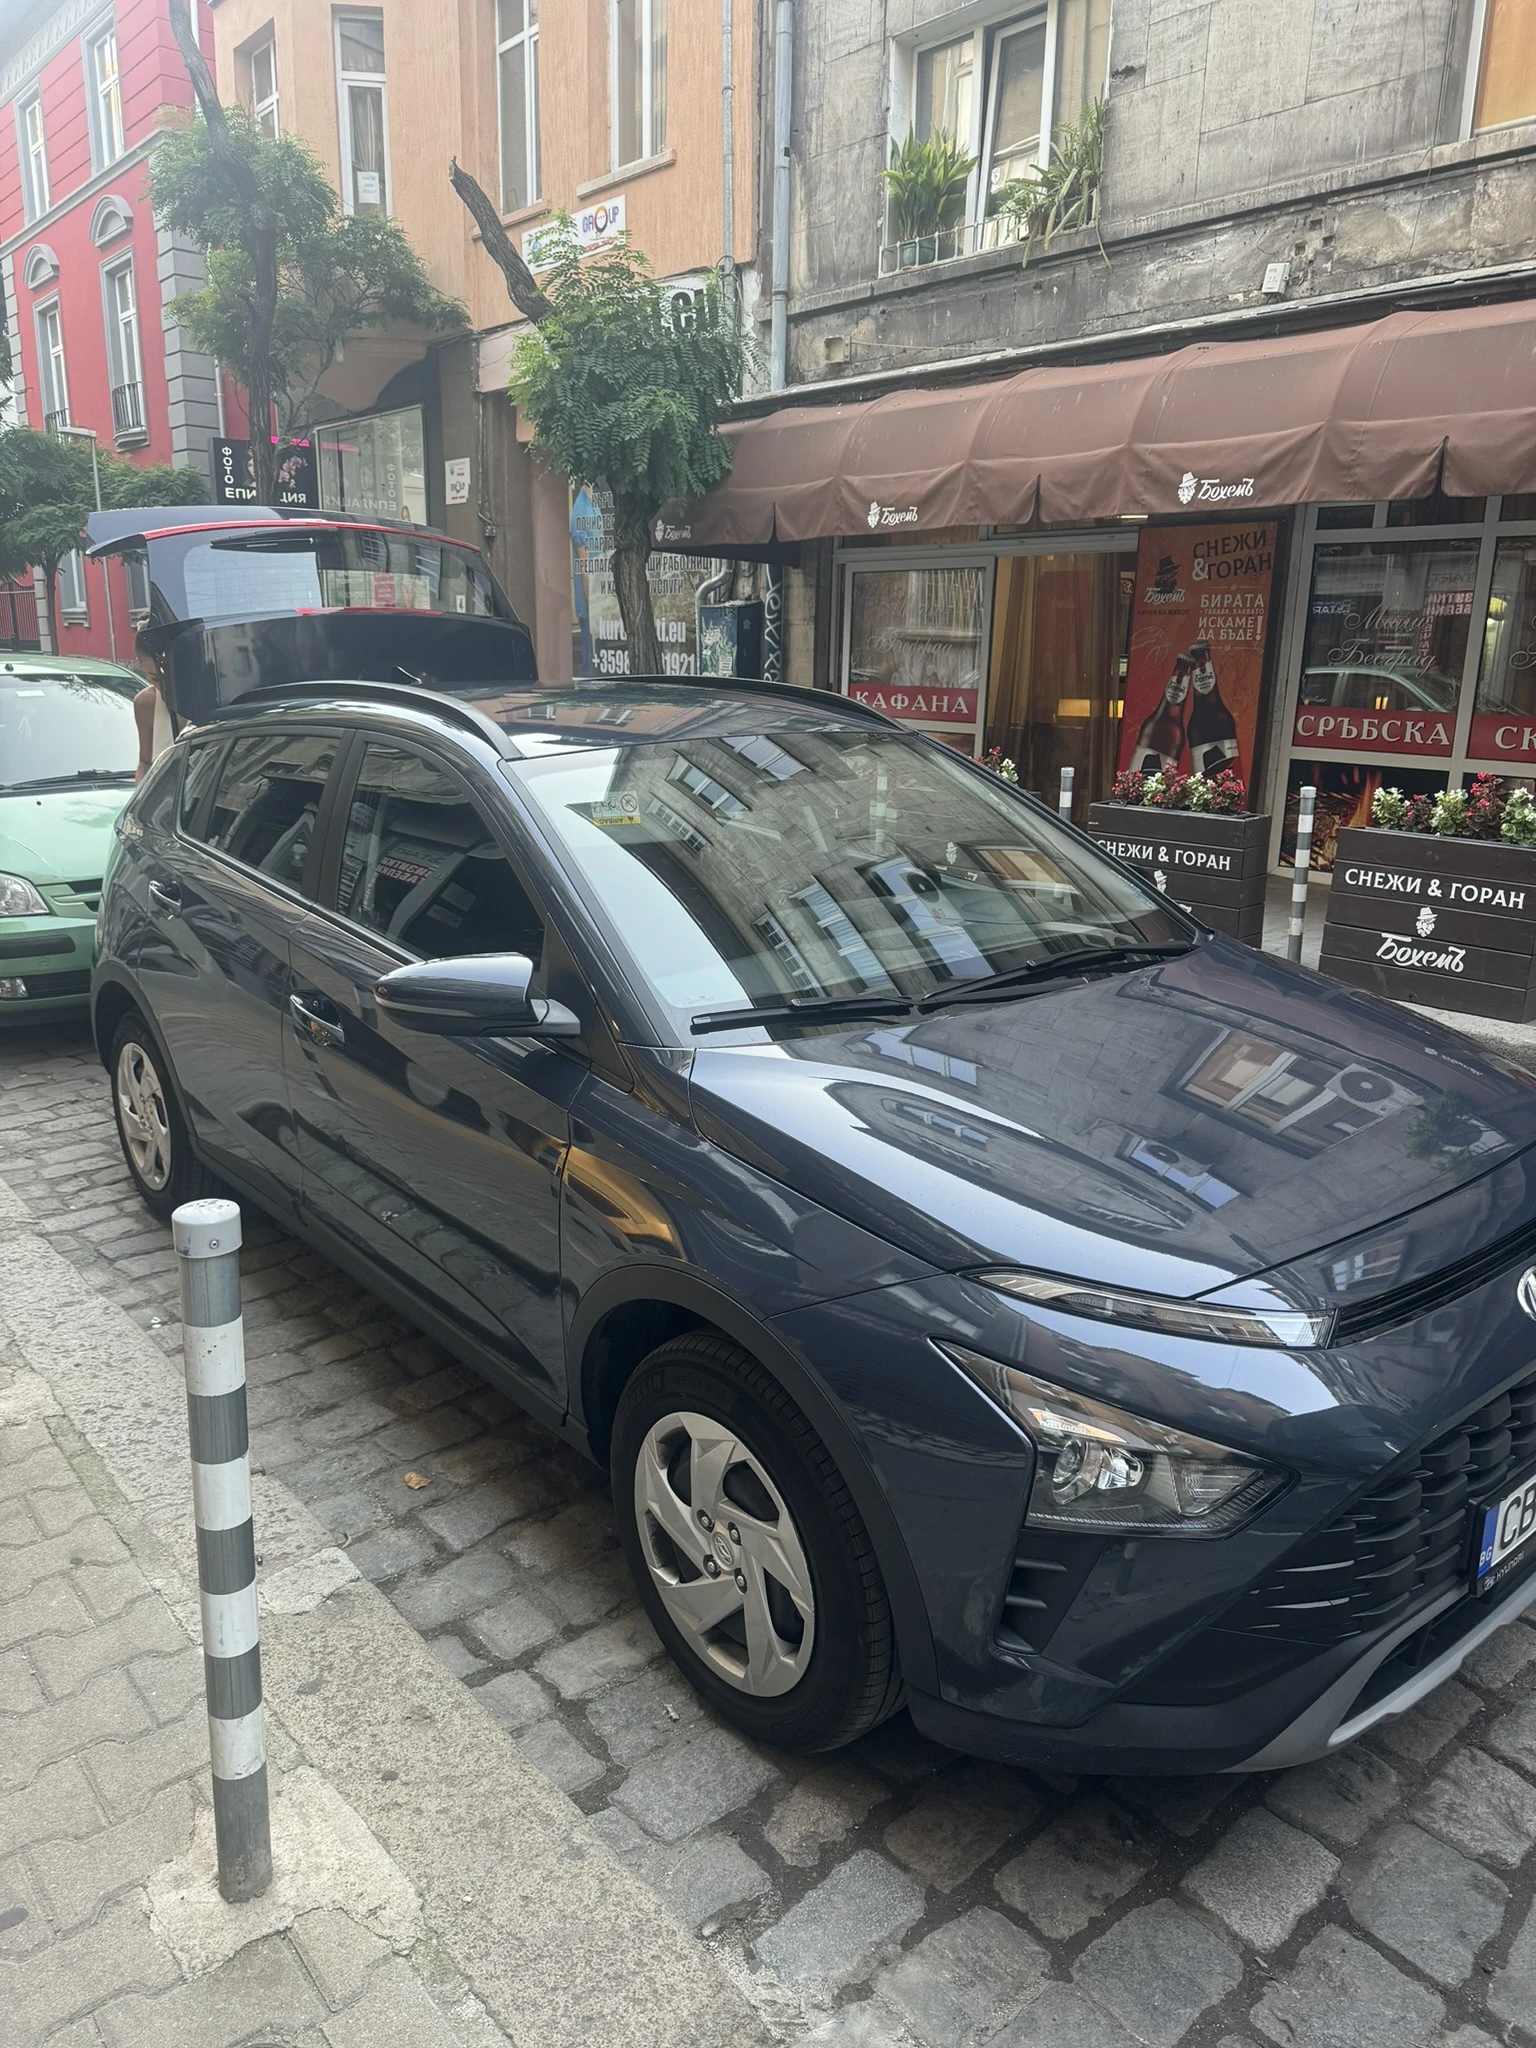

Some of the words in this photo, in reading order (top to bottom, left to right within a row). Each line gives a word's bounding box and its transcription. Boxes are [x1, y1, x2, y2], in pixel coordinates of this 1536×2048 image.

[221, 446, 235, 484] ФОТО
[225, 487, 307, 504] ЕПИЦИЯ
[591, 491, 615, 509] КЪРТ
[584, 535, 615, 553] АПАРТА
[1193, 529, 1267, 559] СНЕЖИ
[574, 557, 614, 575] ПРЕДЛАГА
[1200, 594, 1265, 608] БИРАТА
[1233, 608, 1265, 616] КАКВАТО
[1198, 616, 1255, 629] ИСКАМЕ
[1197, 629, 1215, 640] ДА
[855, 690, 969, 714] КАФАНА
[1296, 714, 1451, 746] СРЪБСКА
[1157, 845, 1169, 862] &
[1174, 849, 1231, 871] ГОРАН
[1344, 868, 1422, 894] СНЕЖИ
[1427, 878, 1442, 898] &
[1449, 882, 1526, 909] ГОРАН
[1479, 1545, 1493, 1567] BG
[1496, 1550, 1525, 1580] HYUNDAI
